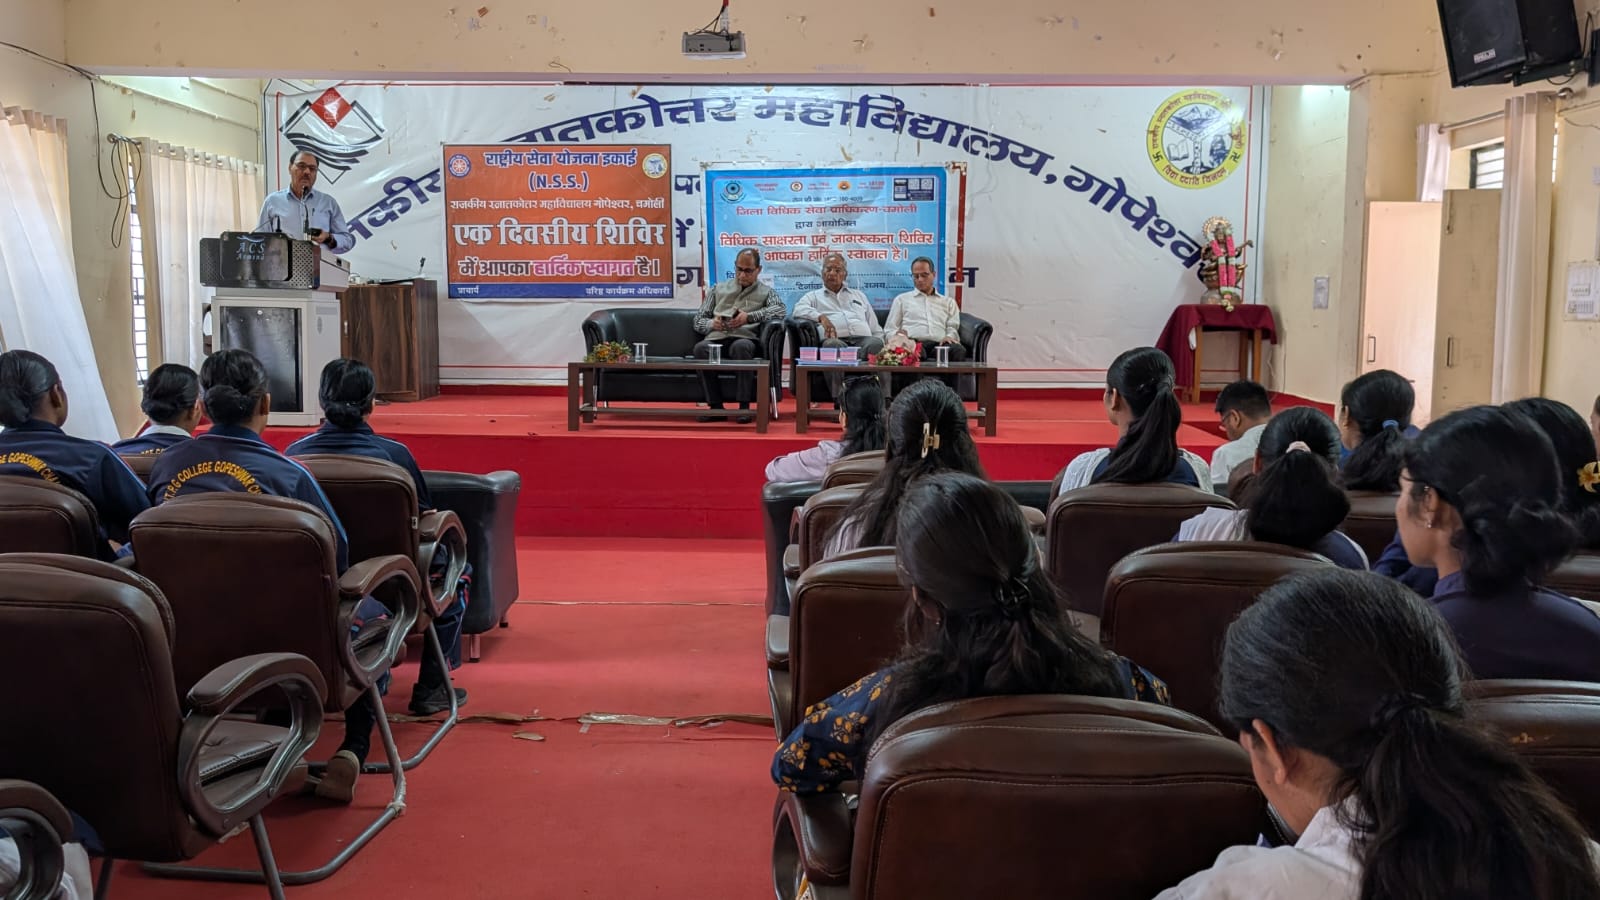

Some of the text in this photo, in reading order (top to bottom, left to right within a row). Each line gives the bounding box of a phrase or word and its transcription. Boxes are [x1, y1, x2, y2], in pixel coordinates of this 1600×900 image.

[485, 150, 523, 168] राष्ट्रीय
[526, 150, 552, 165] सेवा
[555, 150, 600, 165] योजना
[602, 148, 638, 167] इकाई
[528, 171, 589, 193] (N.S.S.)
[636, 197, 665, 209] चमोली
[736, 206, 763, 216] जिला
[767, 206, 801, 216] विधिक
[805, 205, 827, 214] सेवा
[452, 216, 667, 246] एक दिवसीय शिविर
[1063, 165, 1205, 283] गोपेश्व
[720, 233, 758, 246] विधिक
[762, 234, 807, 246] साक्षरता
[811, 231, 827, 245] एवं
[898, 230, 934, 244] शिविर
[458, 257, 478, 276] में
[479, 260, 530, 277] आपका
[532, 254, 582, 277] हार्दिक
[583, 260, 634, 277] स्वागत
[764, 251, 804, 261] आपका
[847, 250, 888, 260] स्वागत
[177, 461, 213, 482] COLLEGE
